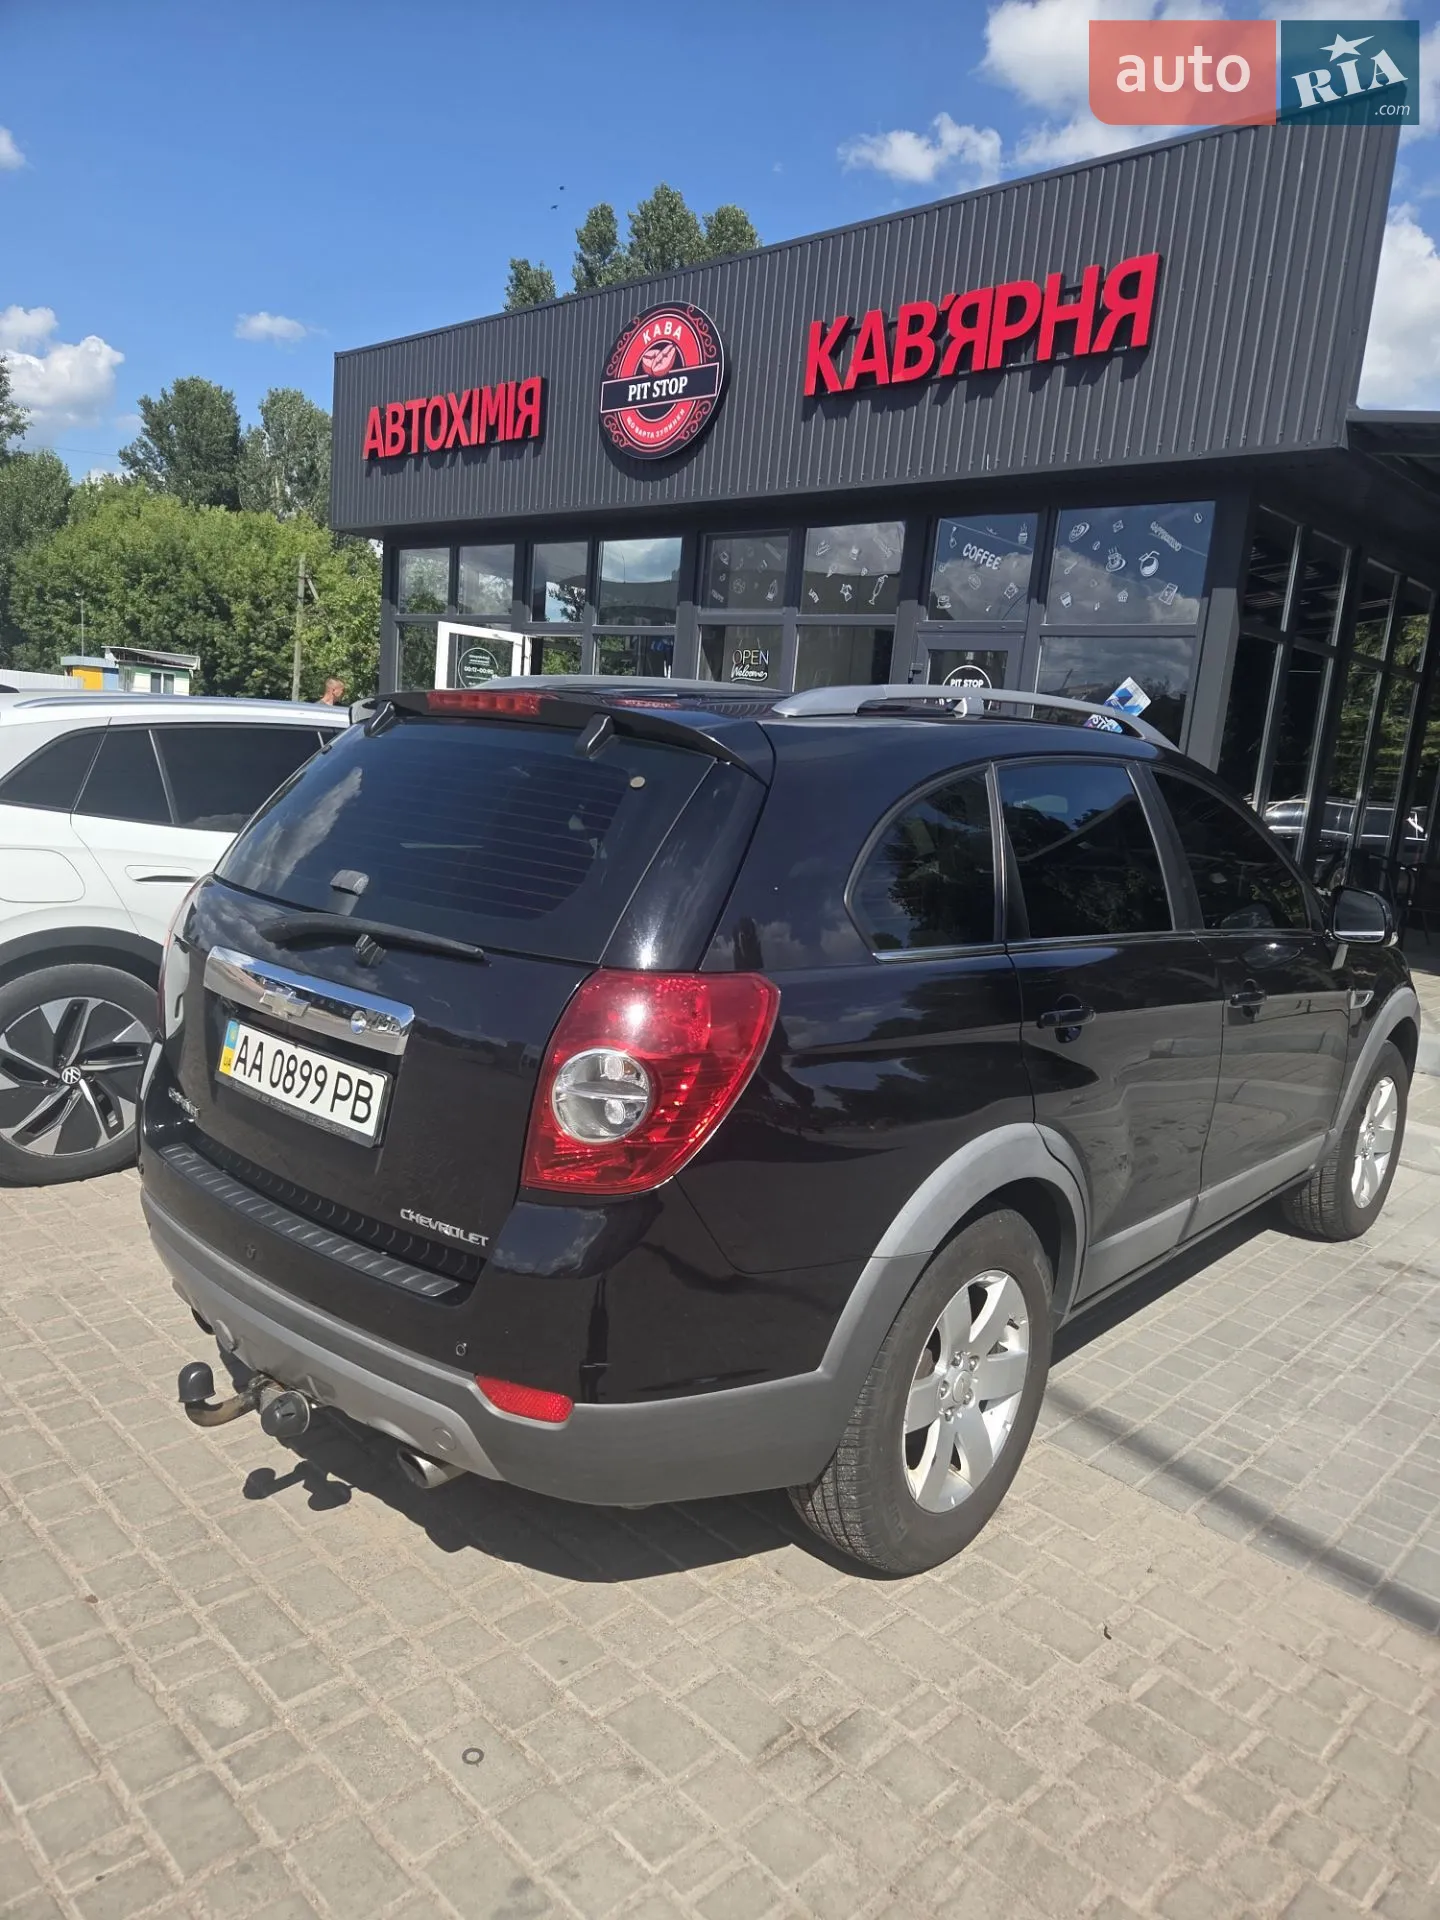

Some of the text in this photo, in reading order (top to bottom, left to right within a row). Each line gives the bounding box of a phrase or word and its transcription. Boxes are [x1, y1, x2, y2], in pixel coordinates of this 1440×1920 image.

[642, 320, 682, 345] КАВА
[804, 252, 1160, 396] КАВ'ЯРНЯ
[627, 375, 688, 402] PIT STOP
[362, 375, 544, 460] АВТОХІМІЯ
[962, 543, 1001, 570] COFFEE
[732, 649, 769, 665] OPEN
[730, 664, 768, 682] Welcome
[950, 679, 984, 688] PIT STOP
[233, 1034, 264, 1083] AA
[269, 1048, 328, 1105] 0899
[330, 1070, 373, 1124] PB
[400, 1208, 490, 1247] CHEVROLET
